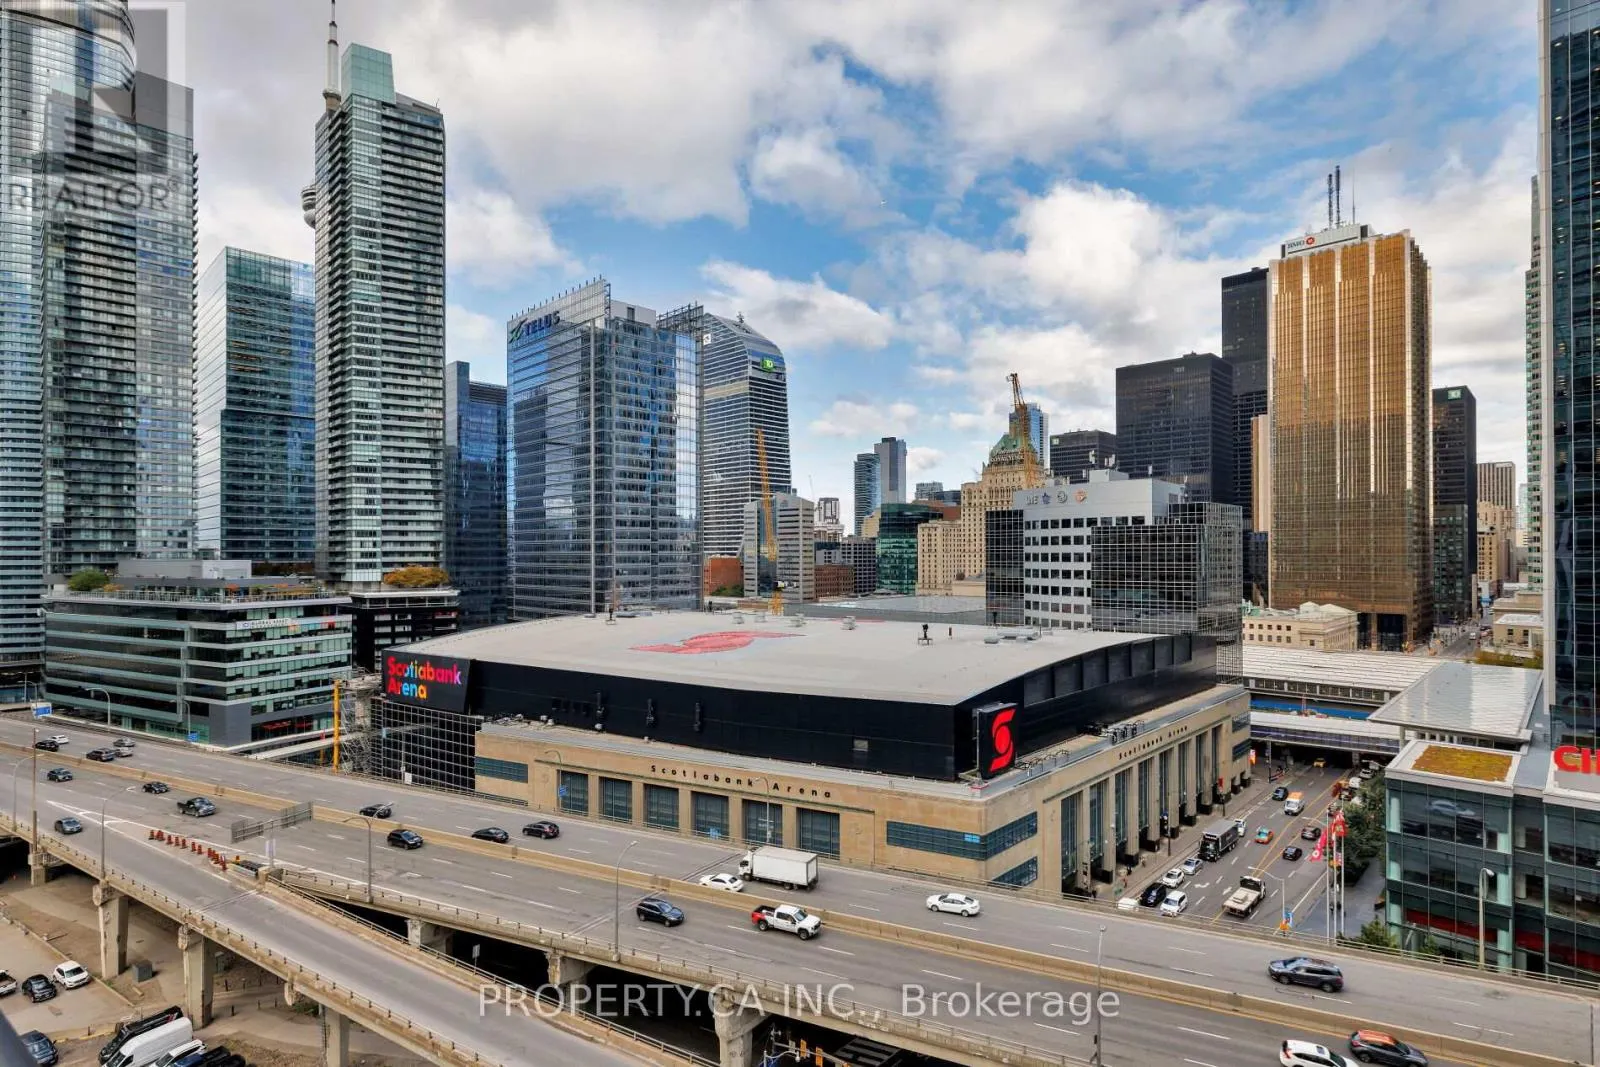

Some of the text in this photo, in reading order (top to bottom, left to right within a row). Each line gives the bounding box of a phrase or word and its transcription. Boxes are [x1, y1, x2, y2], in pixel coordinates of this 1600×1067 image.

[523, 310, 560, 336] TELUS
[387, 656, 462, 685] Scotiabank
[388, 677, 427, 699] Arena
[1554, 745, 1600, 776] CI
[651, 765, 831, 798] Scotiabank Arena
